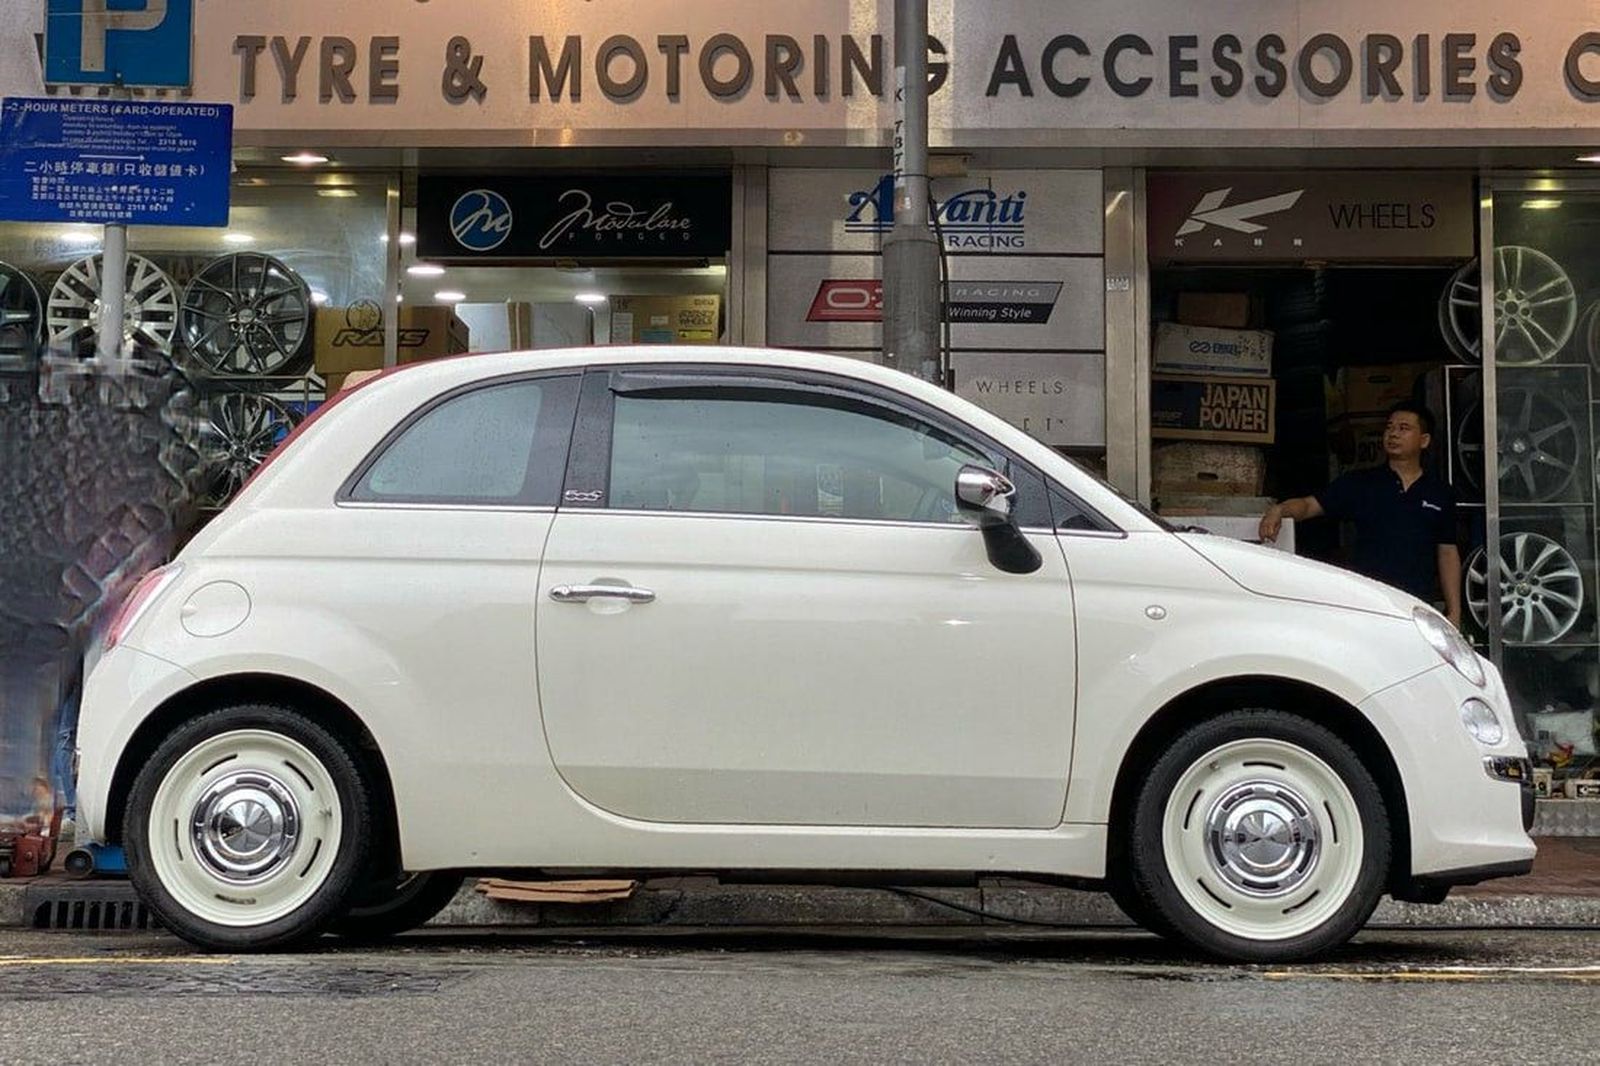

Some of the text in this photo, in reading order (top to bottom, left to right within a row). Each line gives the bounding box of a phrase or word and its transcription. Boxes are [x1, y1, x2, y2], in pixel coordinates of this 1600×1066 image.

[235, 35, 399, 101] TYRE
[442, 35, 488, 102] &
[985, 32, 1523, 101] ACCESSORIES
[60, 103, 108, 114] METERS
[539, 188, 692, 249] Modulare
[1328, 203, 1436, 230] WHEELS
[568, 232, 691, 241] FORGED
[948, 235, 1025, 248] RACING
[955, 287, 1041, 298] RACING
[948, 306, 1033, 320] Winning Style
[332, 327, 431, 348] RAS
[975, 380, 1064, 394] WHEELS
[1200, 383, 1267, 410] JAPAN
[1199, 406, 1267, 431] POWER
